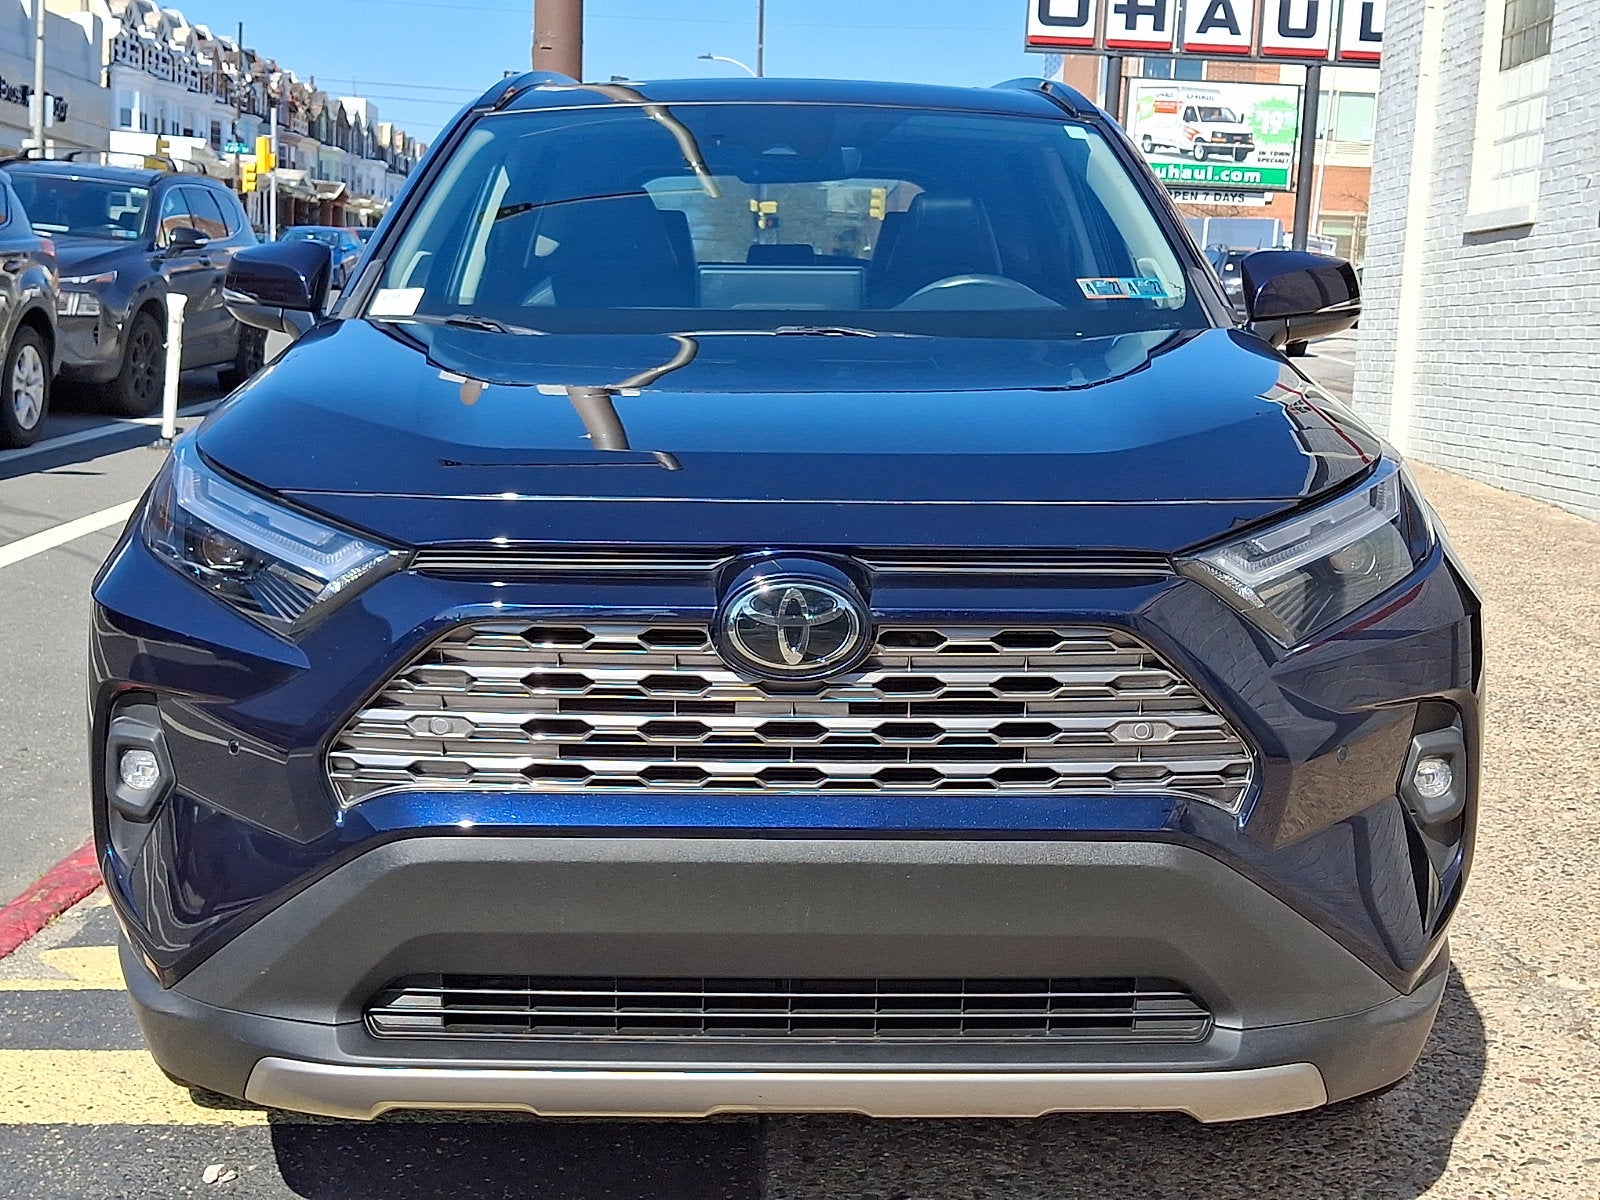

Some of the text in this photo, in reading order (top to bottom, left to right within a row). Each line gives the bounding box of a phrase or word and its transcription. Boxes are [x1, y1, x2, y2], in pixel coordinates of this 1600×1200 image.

[1155, 163, 1261, 183] uhaul.com
[1203, 192, 1210, 201] 7
[1214, 192, 1245, 203] DAYS
